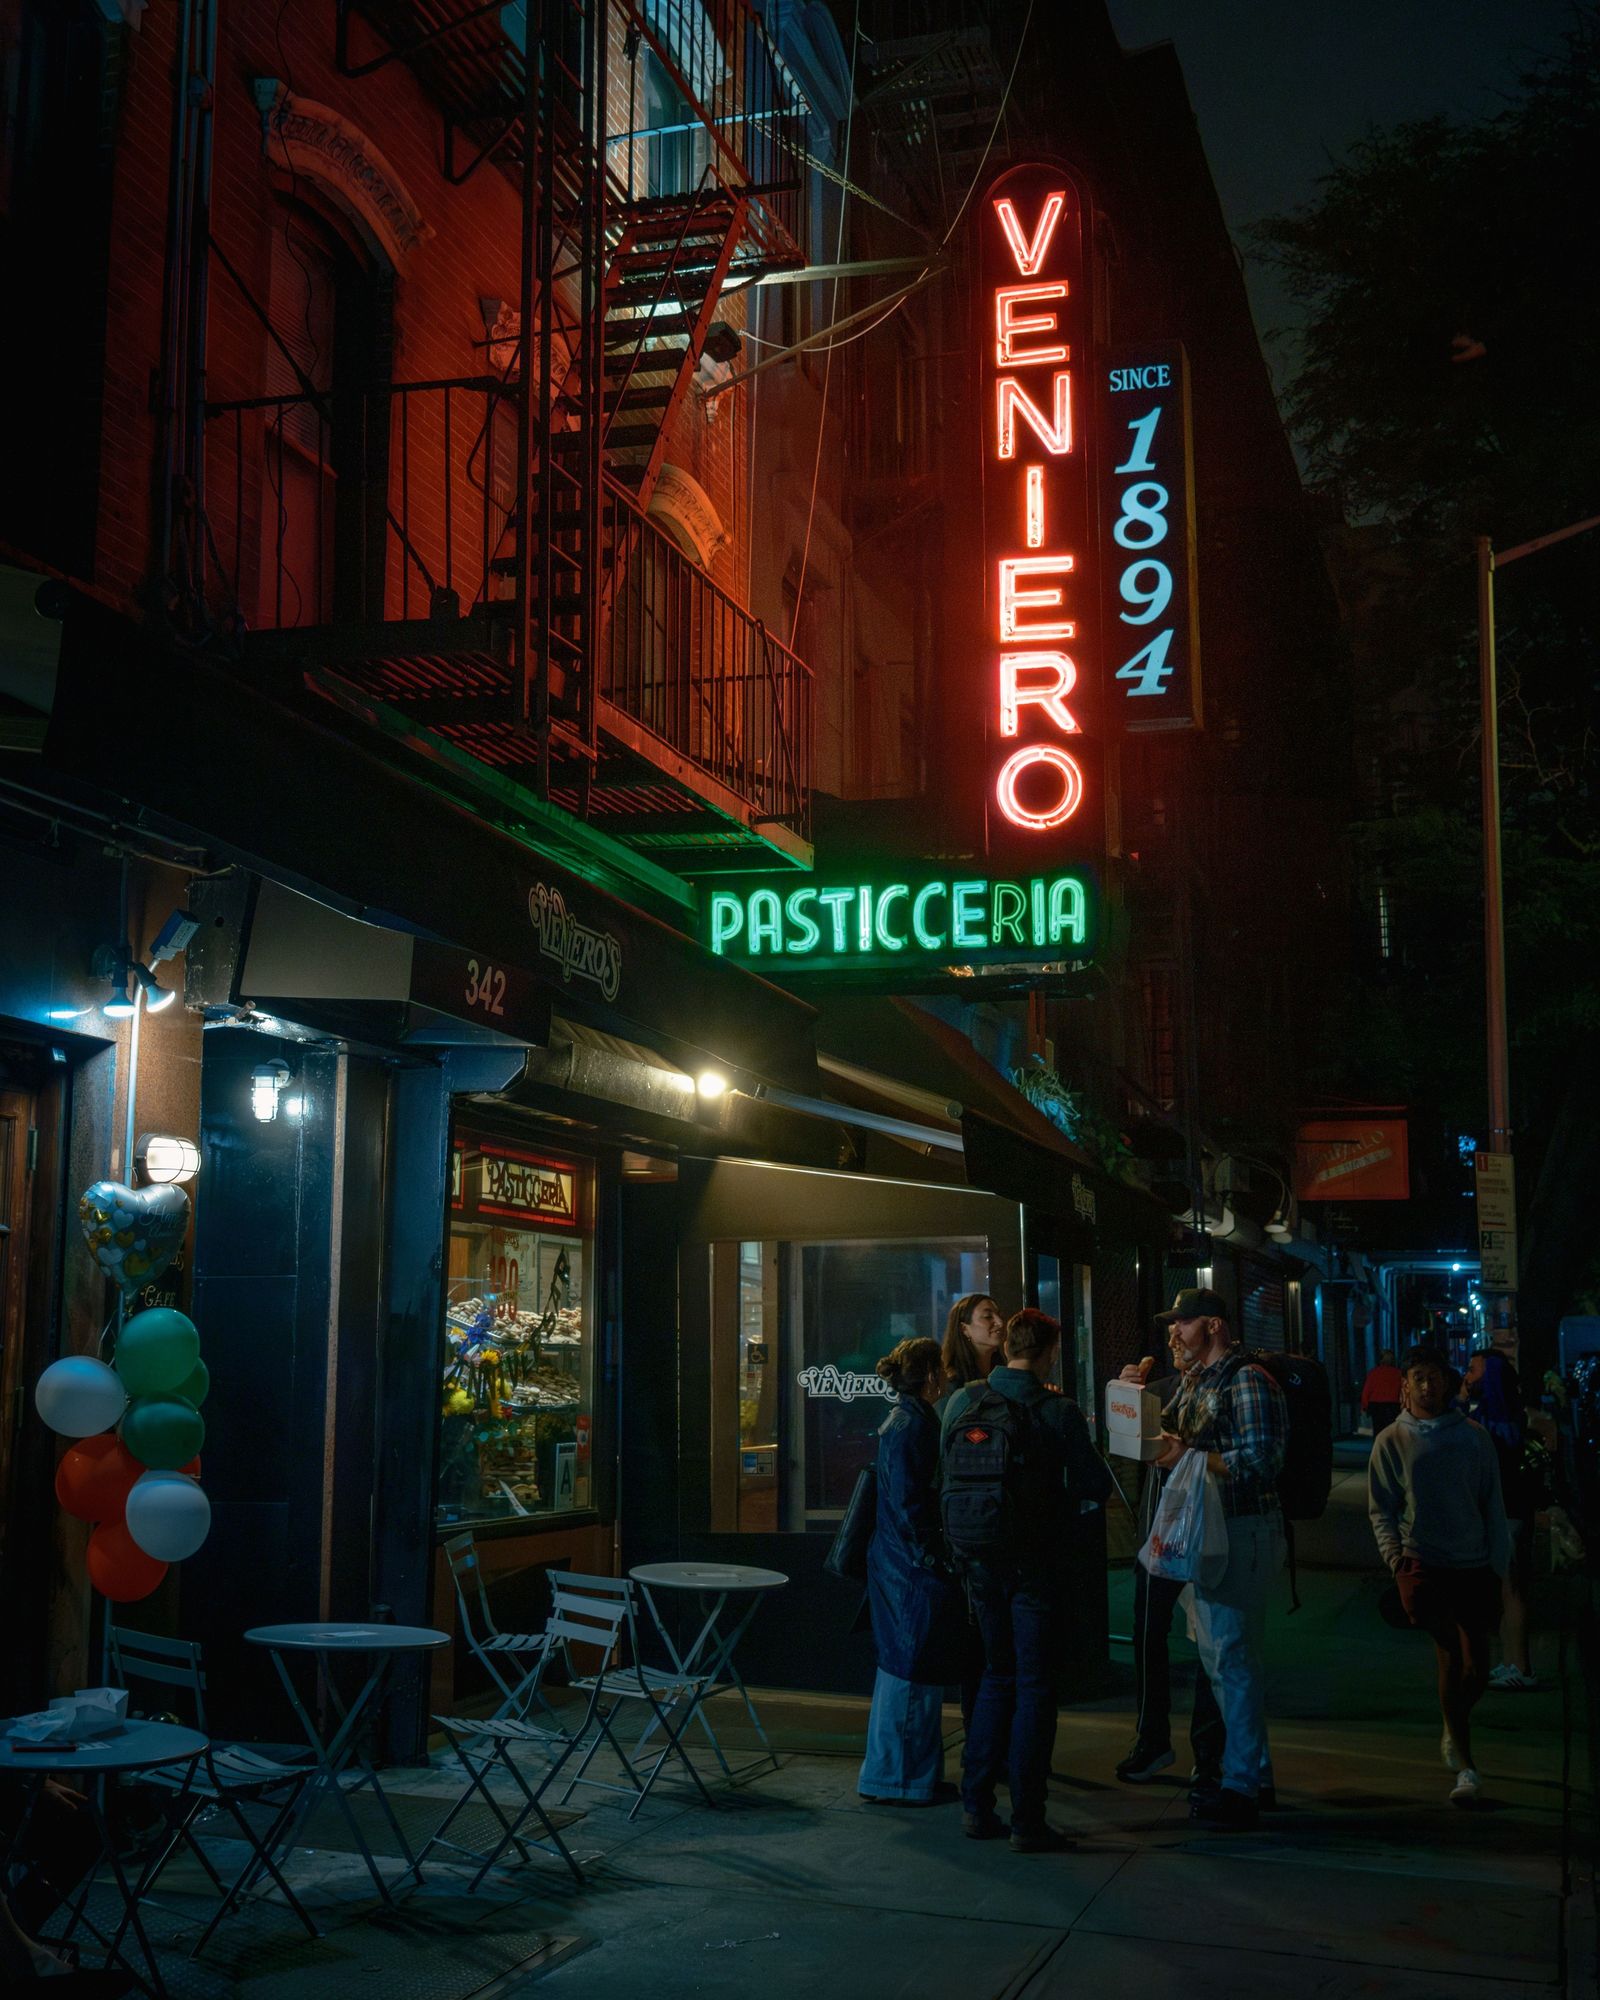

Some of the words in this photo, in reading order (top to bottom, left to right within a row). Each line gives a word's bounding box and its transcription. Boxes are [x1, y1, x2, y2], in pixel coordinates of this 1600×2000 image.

[1109, 364, 1171, 392] SINCE
[993, 191, 1083, 830] VENIERO
[1113, 407, 1174, 697] 1894
[711, 877, 1085, 956] PASTICCERIA
[465, 959, 507, 1017] 342
[797, 1364, 899, 1403] VENIERO
[560, 1459, 572, 1495] A
